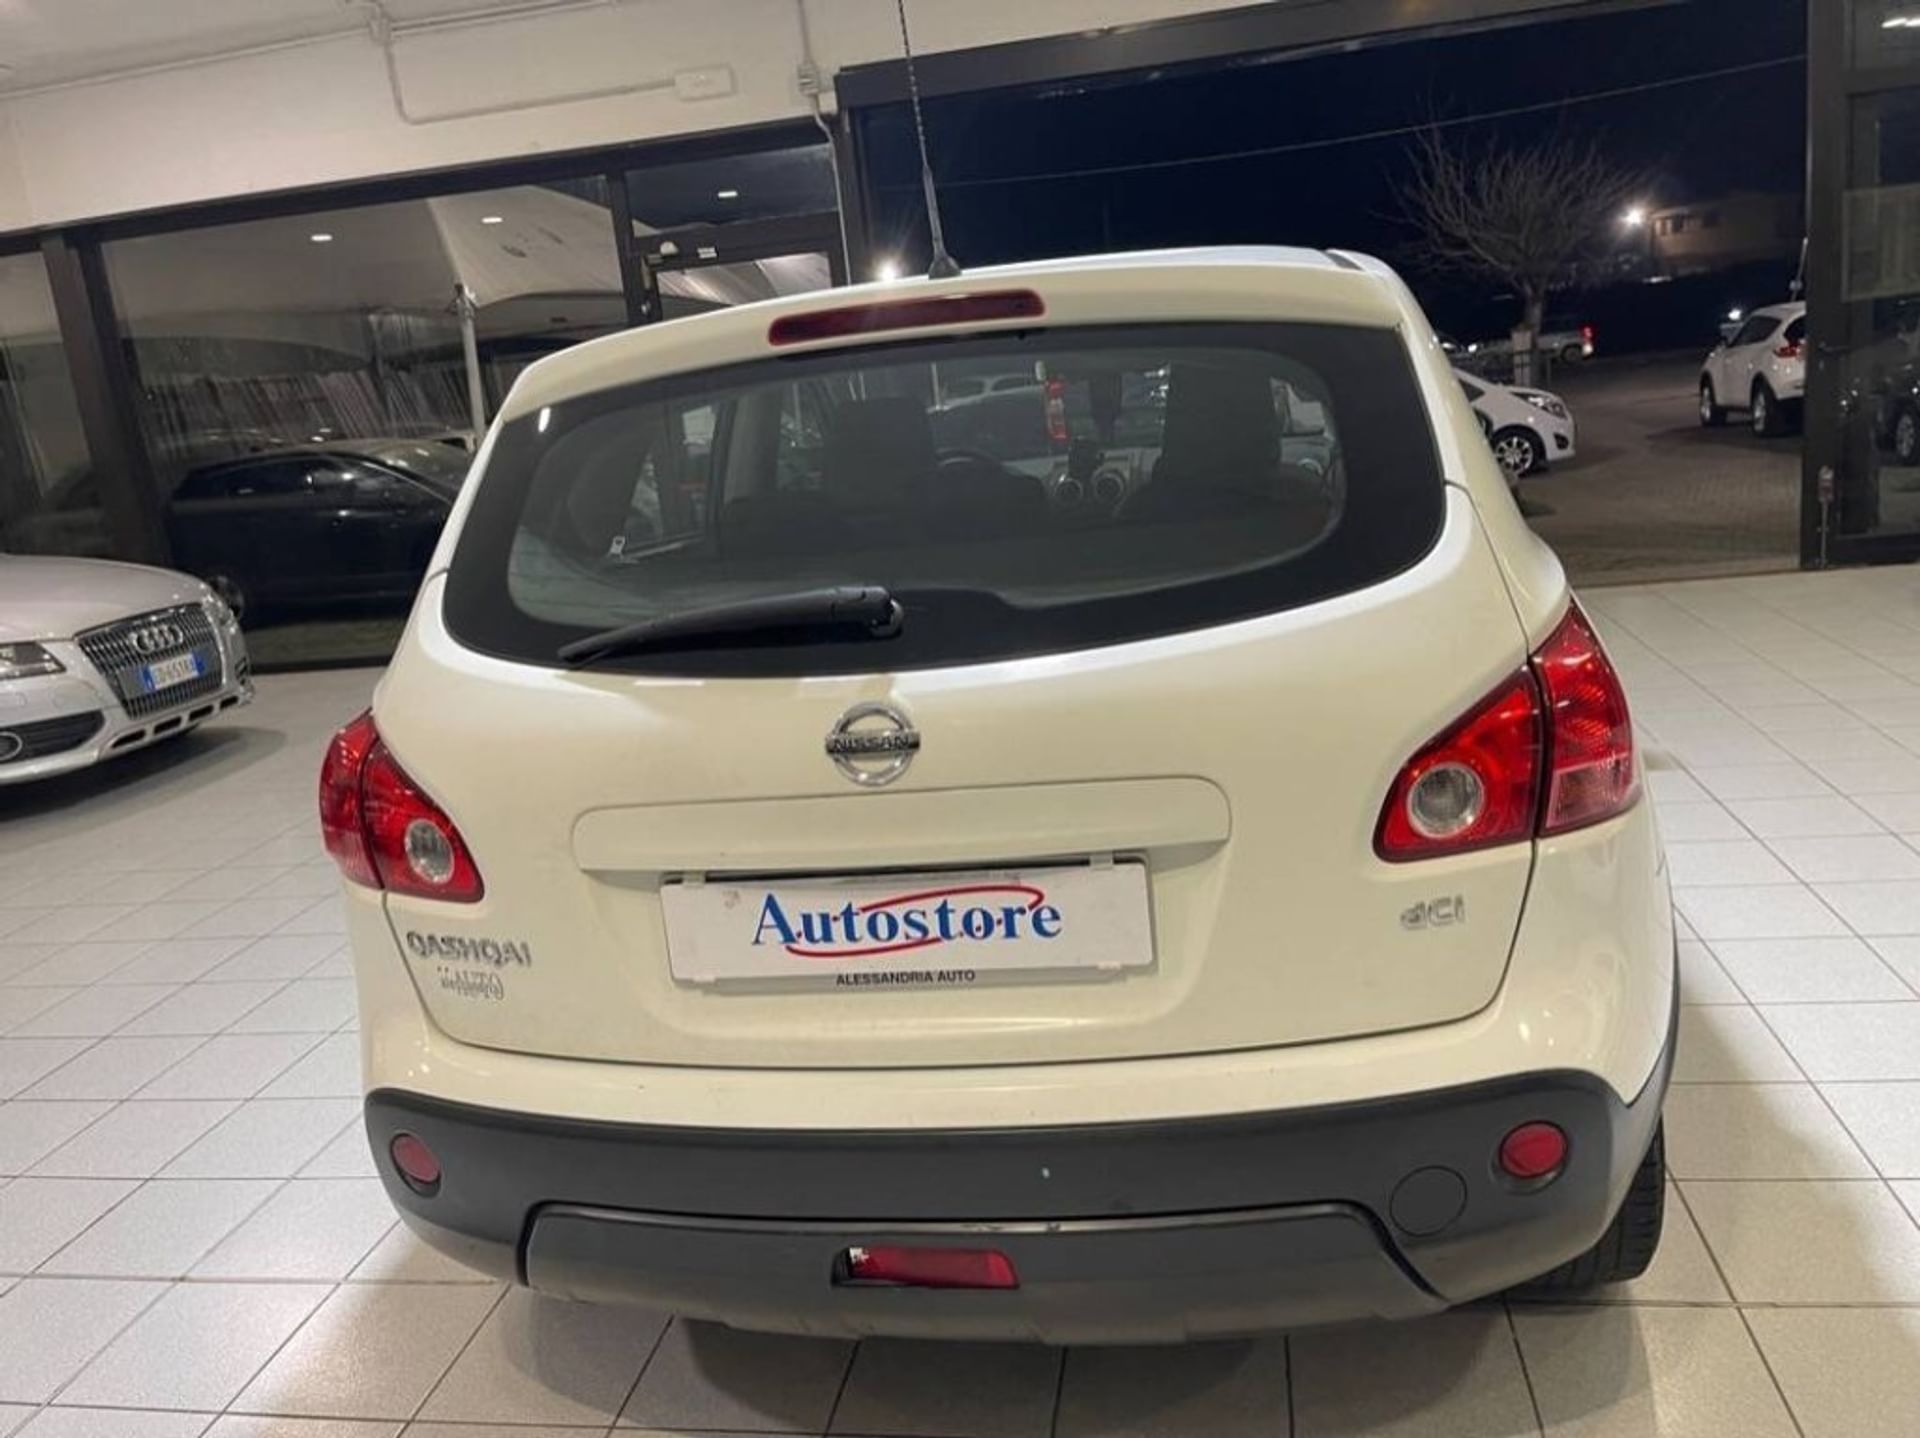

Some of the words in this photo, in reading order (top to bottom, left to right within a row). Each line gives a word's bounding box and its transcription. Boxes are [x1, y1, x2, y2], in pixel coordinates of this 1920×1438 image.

[752, 893, 1062, 946] Autostore
[406, 930, 532, 968] QASHQAI
[836, 970, 934, 986] ALESSANDRIA
[937, 969, 976, 982] AUTO
